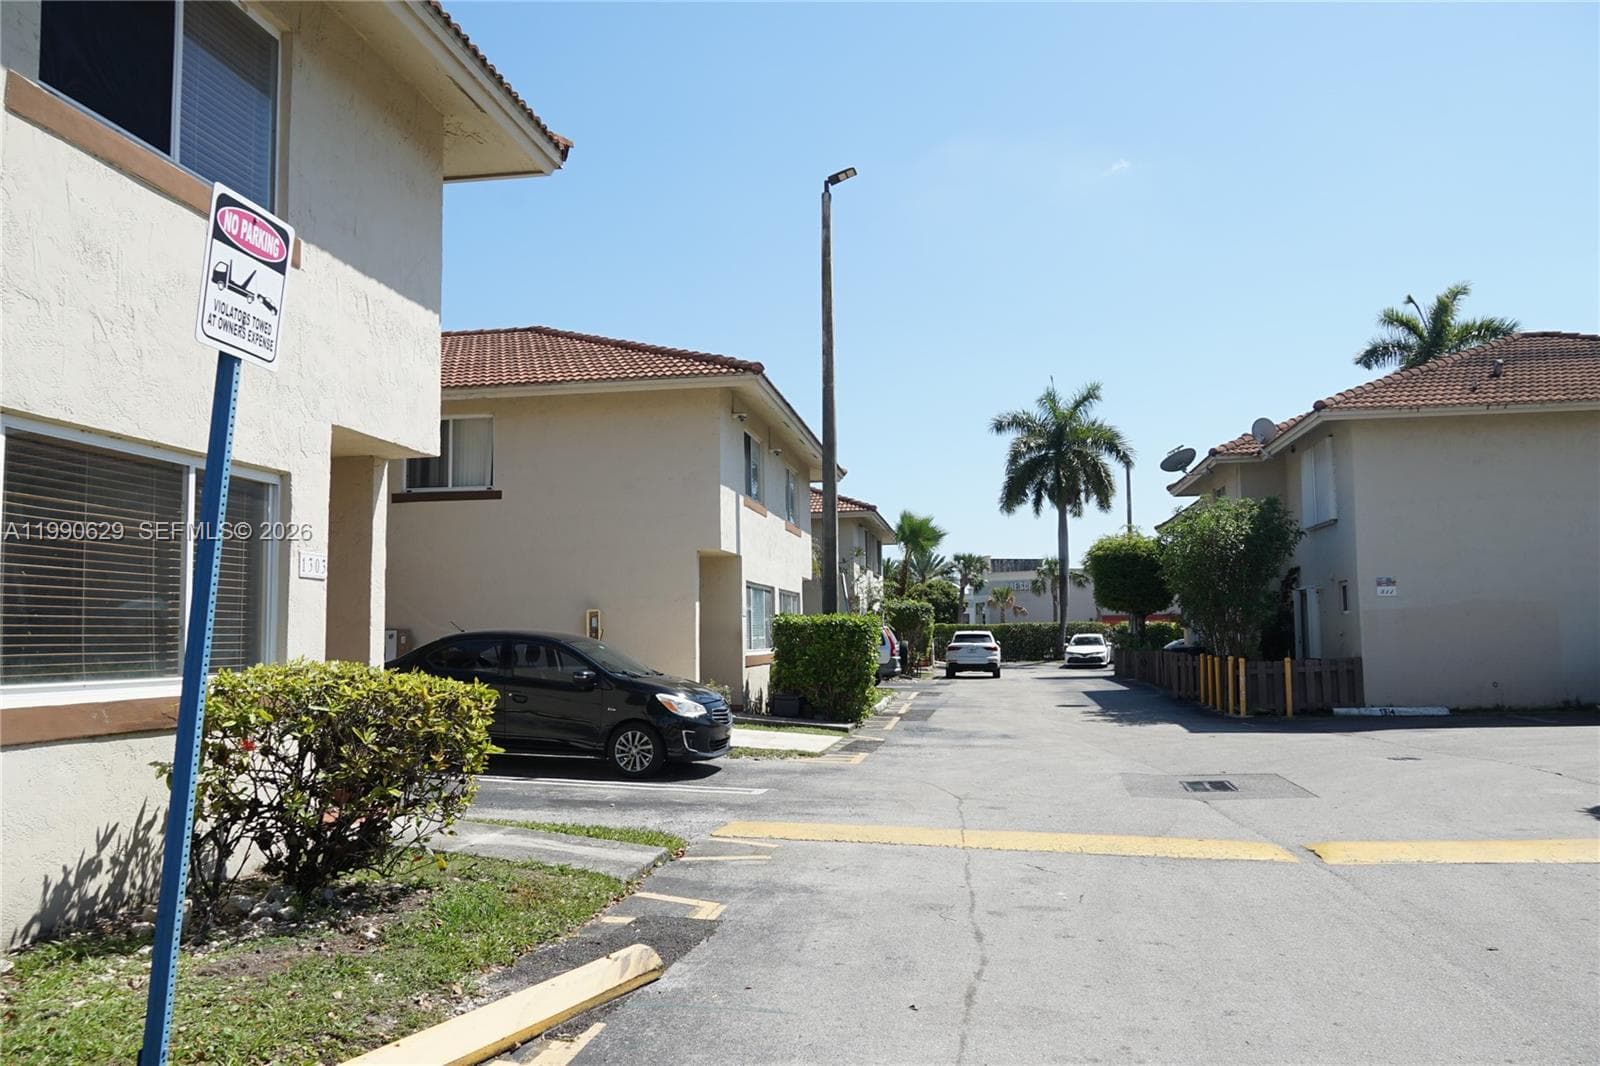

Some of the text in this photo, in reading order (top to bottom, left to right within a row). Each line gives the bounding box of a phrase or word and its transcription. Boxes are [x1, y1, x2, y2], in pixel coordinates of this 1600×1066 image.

[223, 209, 280, 258] NO PARKING
[207, 312, 217, 327] AT
[247, 329, 274, 352] EXPENSE
[213, 299, 273, 336] VIOLATORS TOWED
